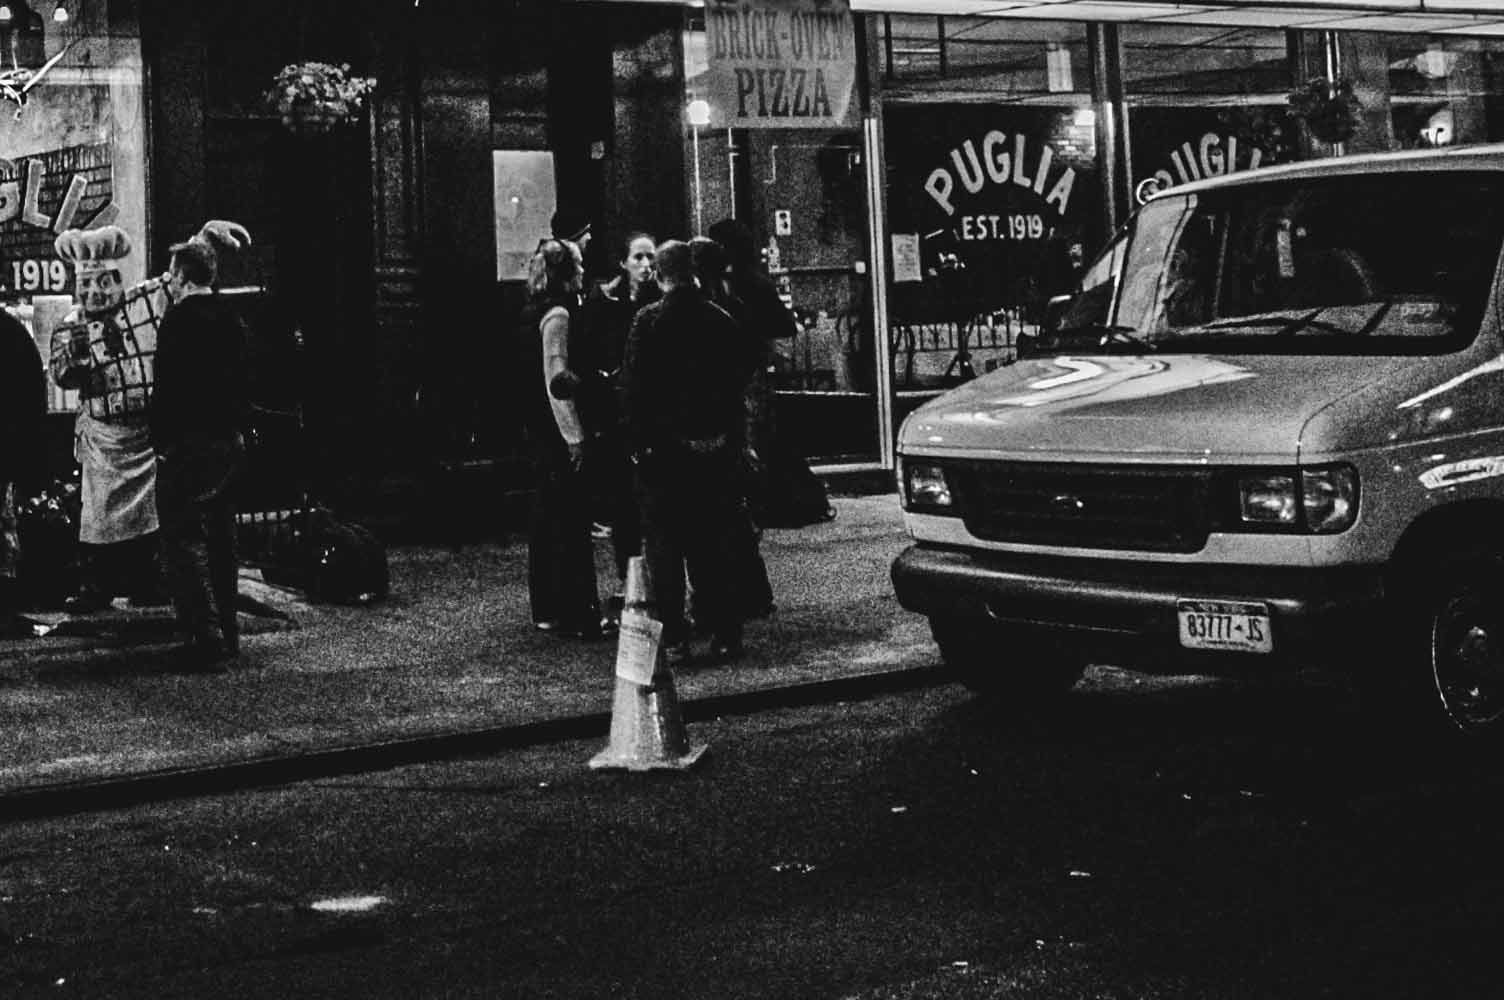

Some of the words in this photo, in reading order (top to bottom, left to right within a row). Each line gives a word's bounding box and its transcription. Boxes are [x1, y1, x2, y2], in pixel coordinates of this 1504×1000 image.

[734, 67, 832, 117] PIZZA
[925, 130, 1075, 215] PUGLIA
[962, 214, 1004, 240] EST.
[1008, 213, 1044, 239] 1919
[12, 259, 67, 292] 1919
